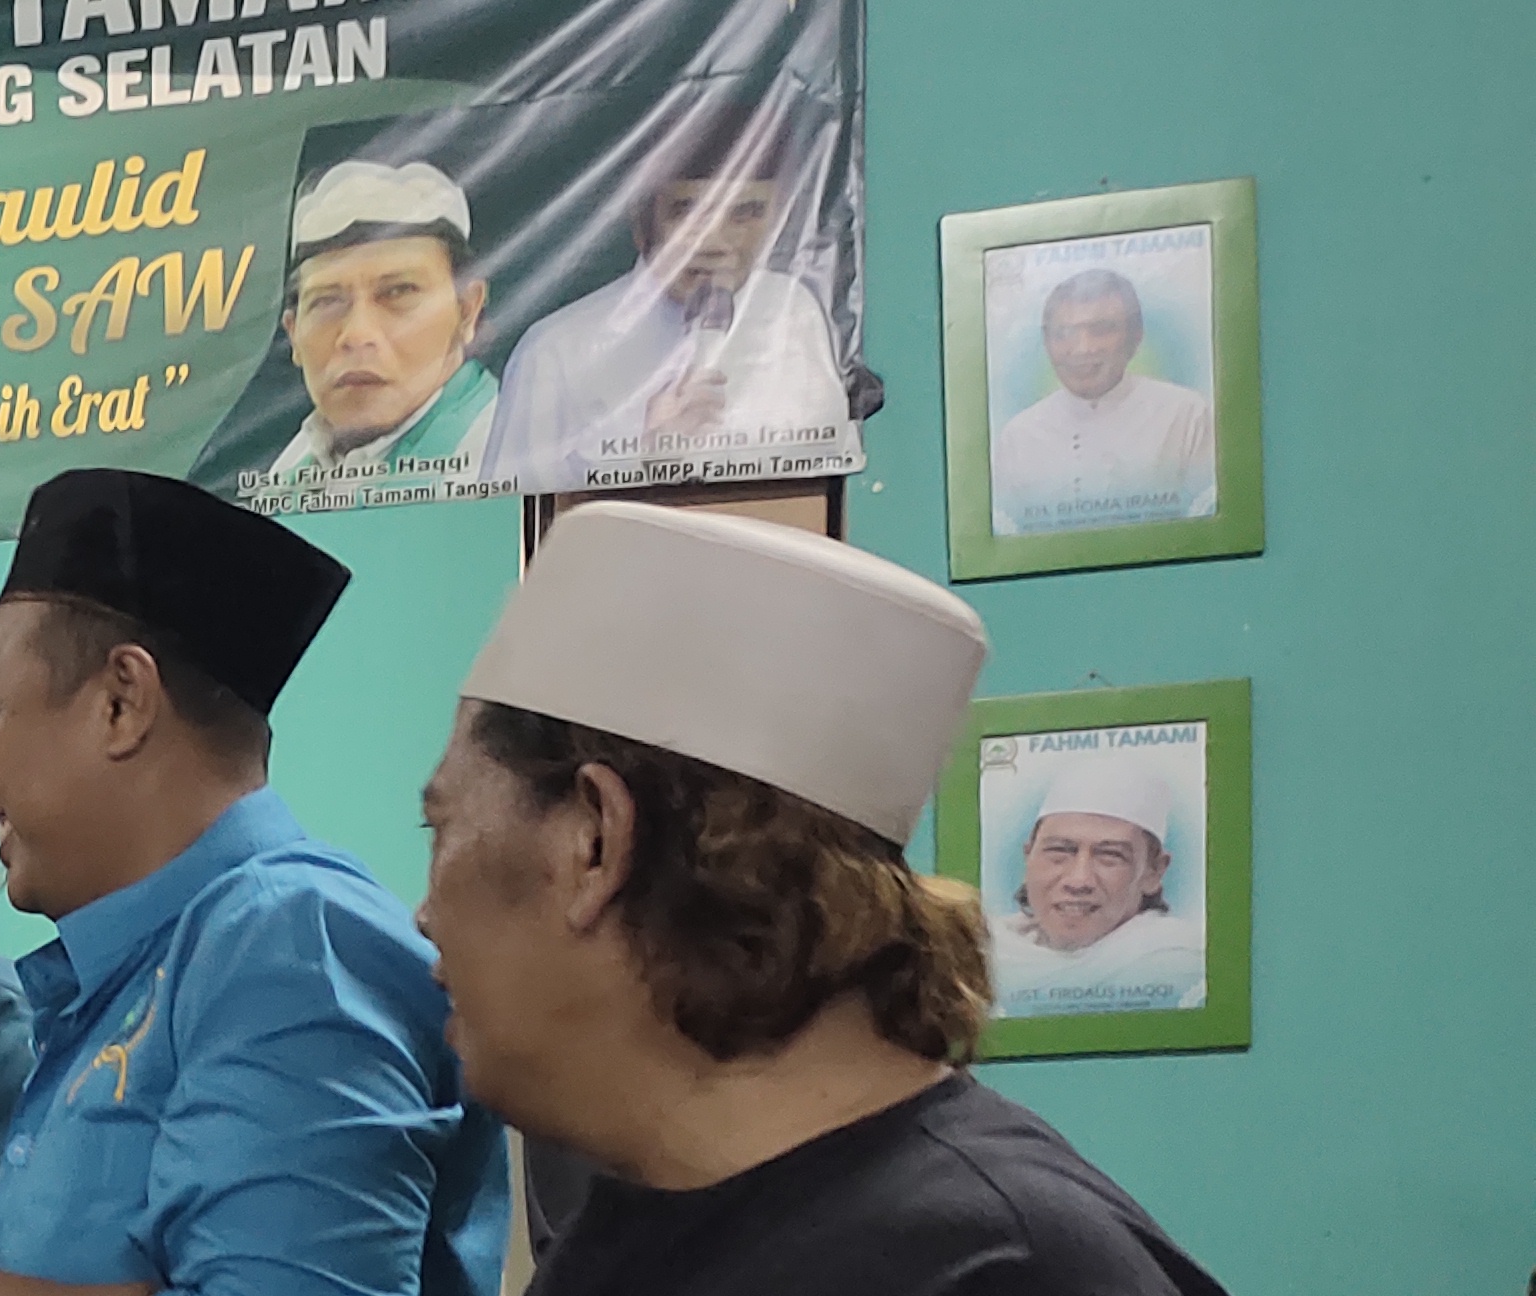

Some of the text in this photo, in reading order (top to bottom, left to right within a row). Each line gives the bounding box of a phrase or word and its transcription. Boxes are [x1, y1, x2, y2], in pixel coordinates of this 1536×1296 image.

[57, 16, 388, 117] SELATAN
[0, 245, 255, 355] SAW
[50, 374, 151, 437] Erat
[657, 431, 749, 452] Rhoma
[758, 424, 837, 444] Irama
[238, 450, 471, 491] Ust. Firdaus Haqqi
[586, 468, 645, 487] Ketua
[650, 462, 695, 481] MPP
[701, 459, 762, 477] Fahmi
[252, 475, 519, 515] MPC Fahmi Tamami Tangsel
[1028, 726, 1198, 753] FAHMI TAMAMI
